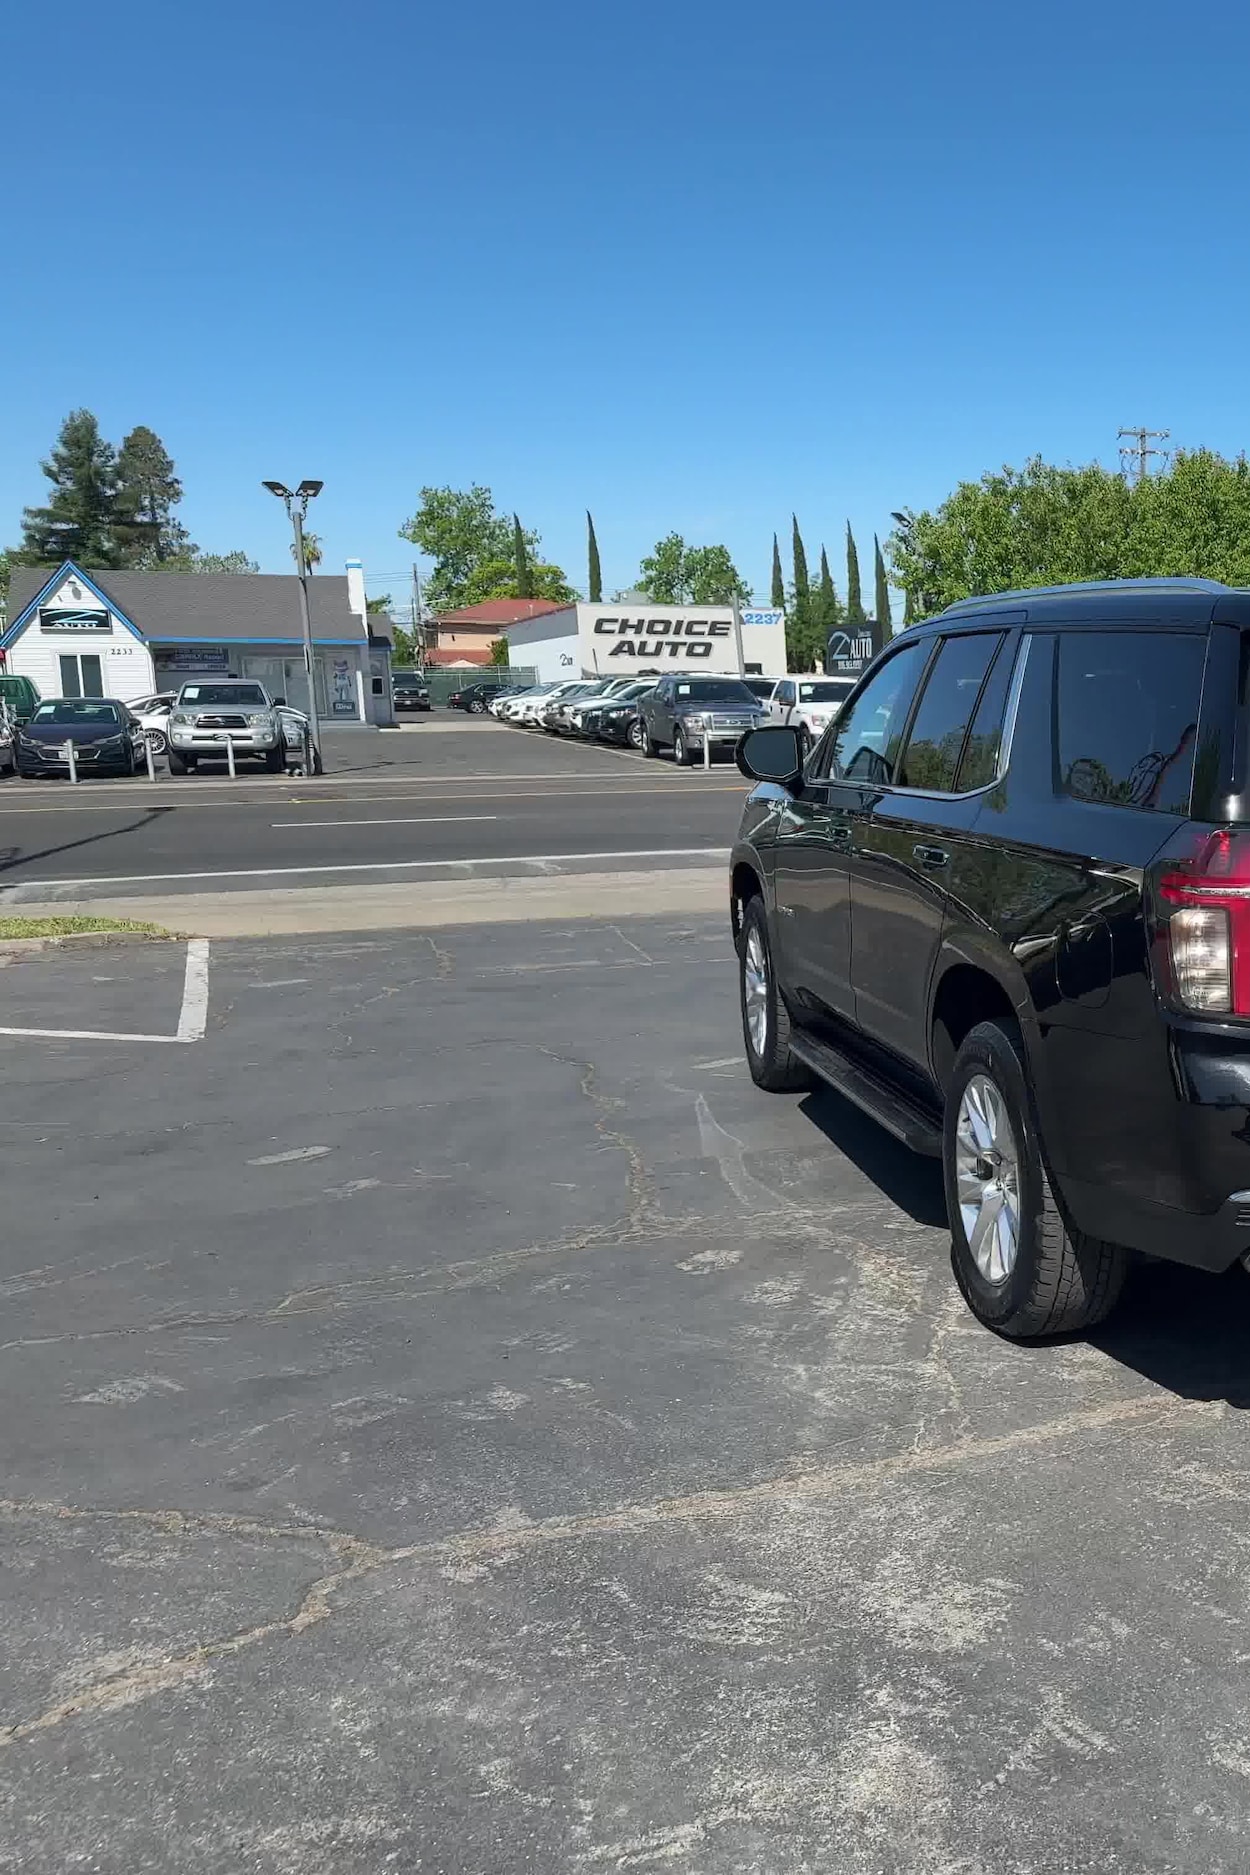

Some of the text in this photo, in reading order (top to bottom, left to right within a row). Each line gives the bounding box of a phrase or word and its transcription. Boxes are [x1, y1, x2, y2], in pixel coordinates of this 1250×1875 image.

[593, 618, 732, 636] CHOICE
[744, 613, 782, 625] 2237
[111, 648, 133, 656] 2233
[608, 640, 713, 657] AUTO
[850, 637, 873, 660] AUTO
